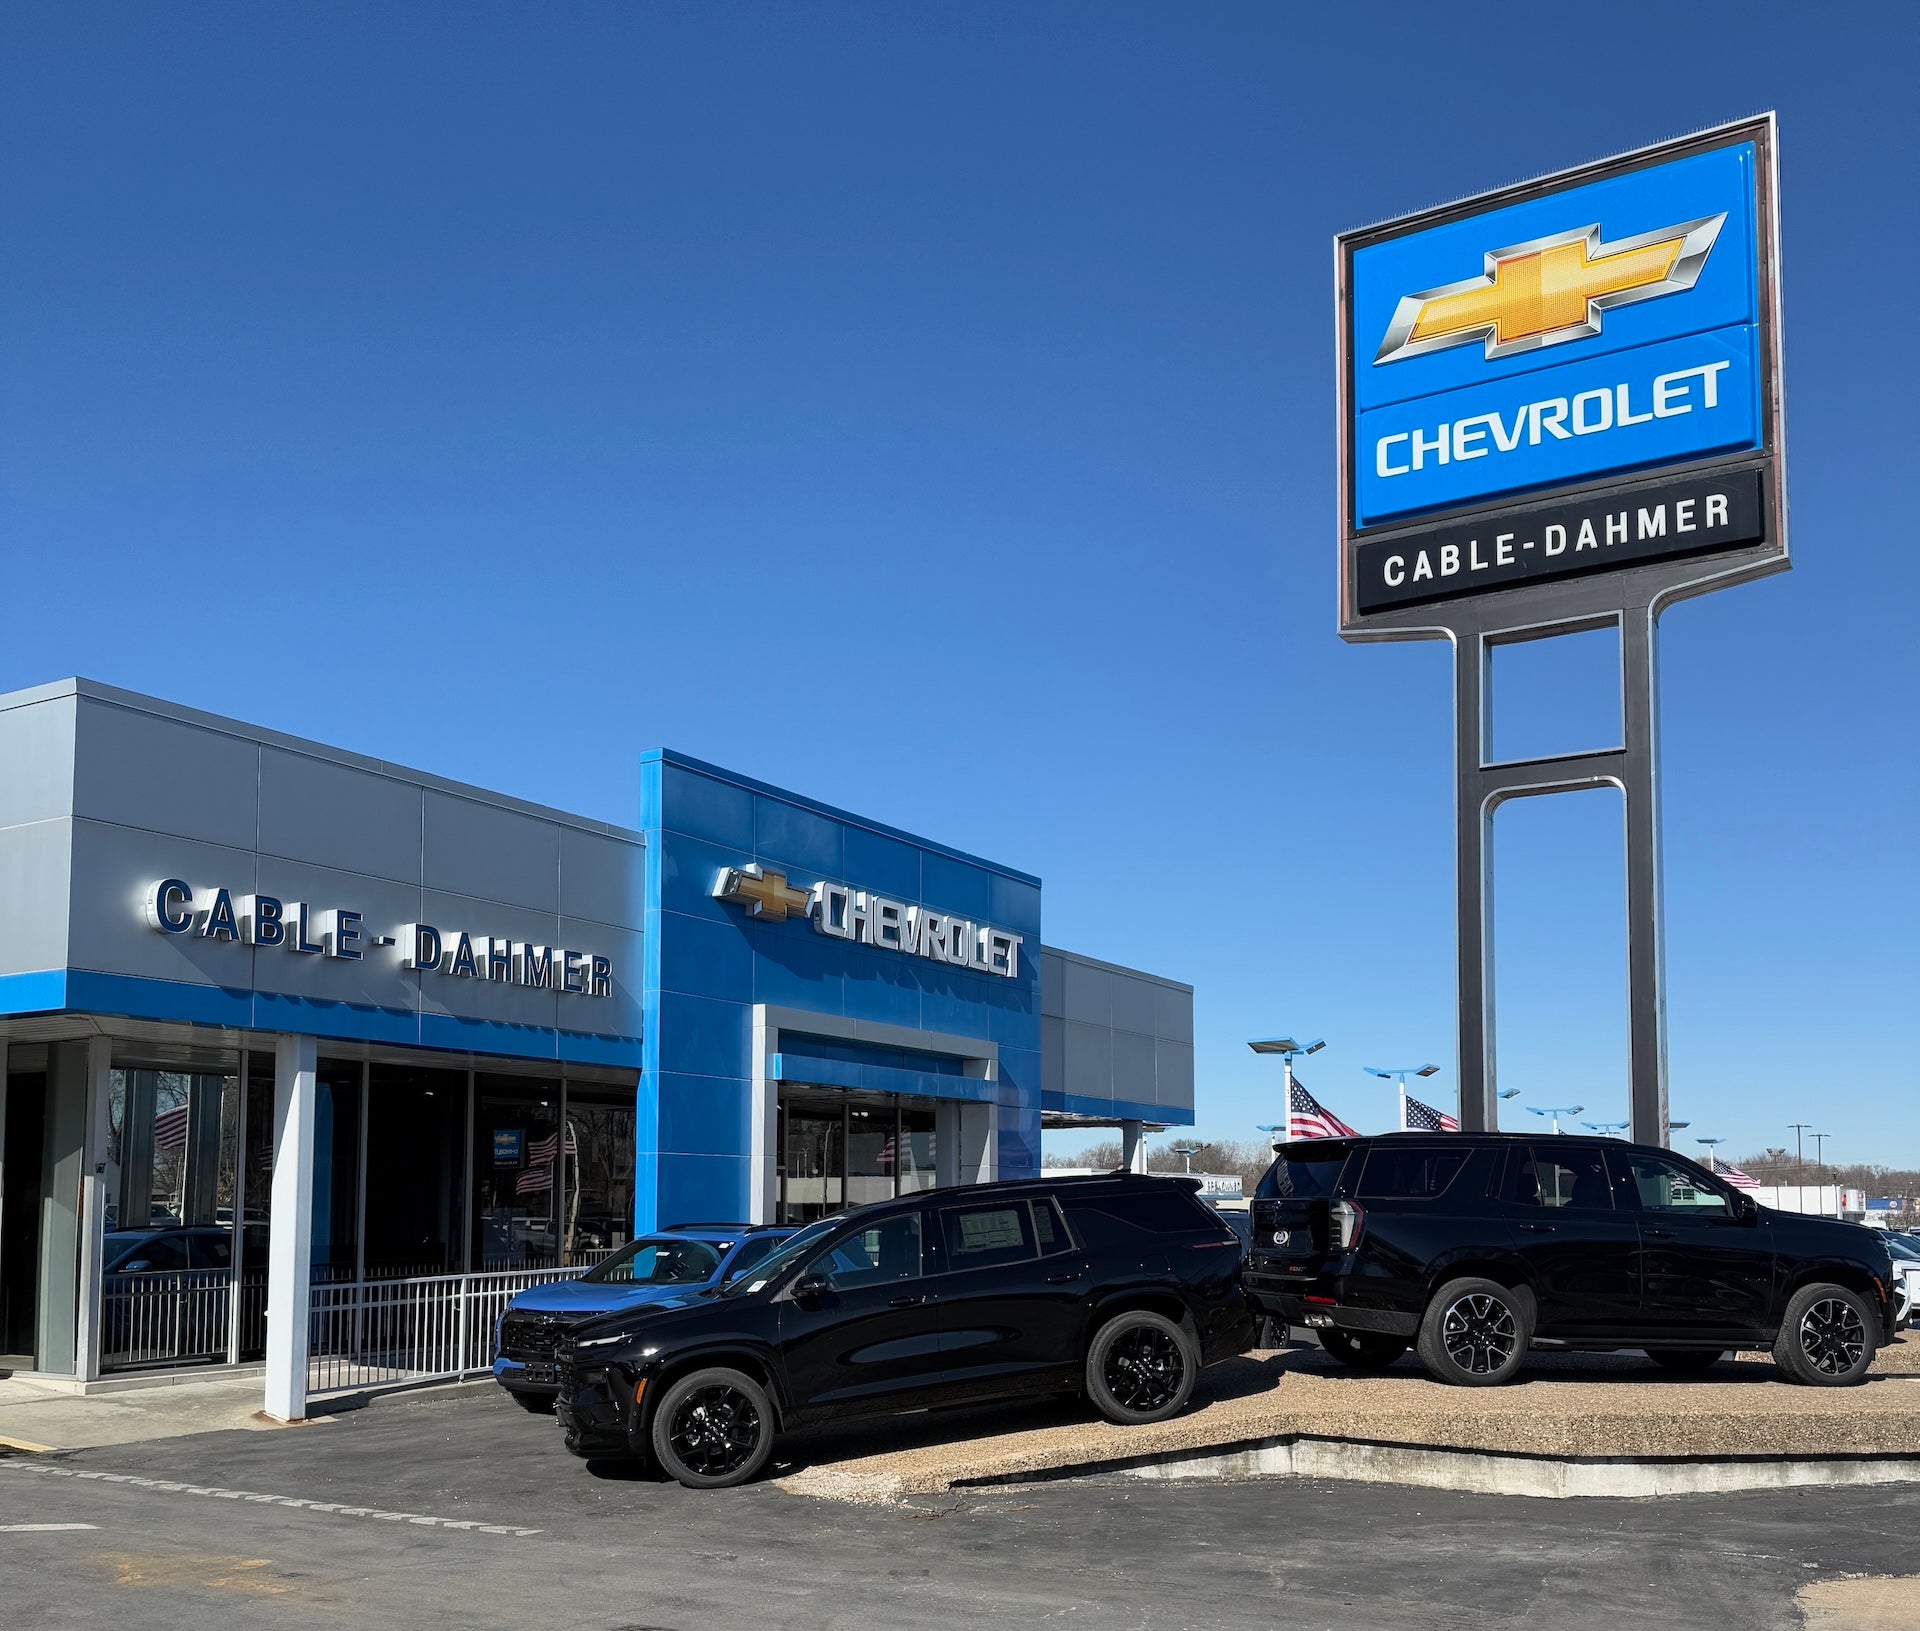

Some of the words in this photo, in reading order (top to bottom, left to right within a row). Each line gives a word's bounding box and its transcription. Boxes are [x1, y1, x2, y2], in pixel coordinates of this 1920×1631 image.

[1376, 360, 1730, 478] CHEVROLET
[1383, 493, 1730, 588] CABLE-DAHMER
[147, 878, 613, 998] CABLE-DAHMER
[814, 881, 1024, 978] CHEVROLET
